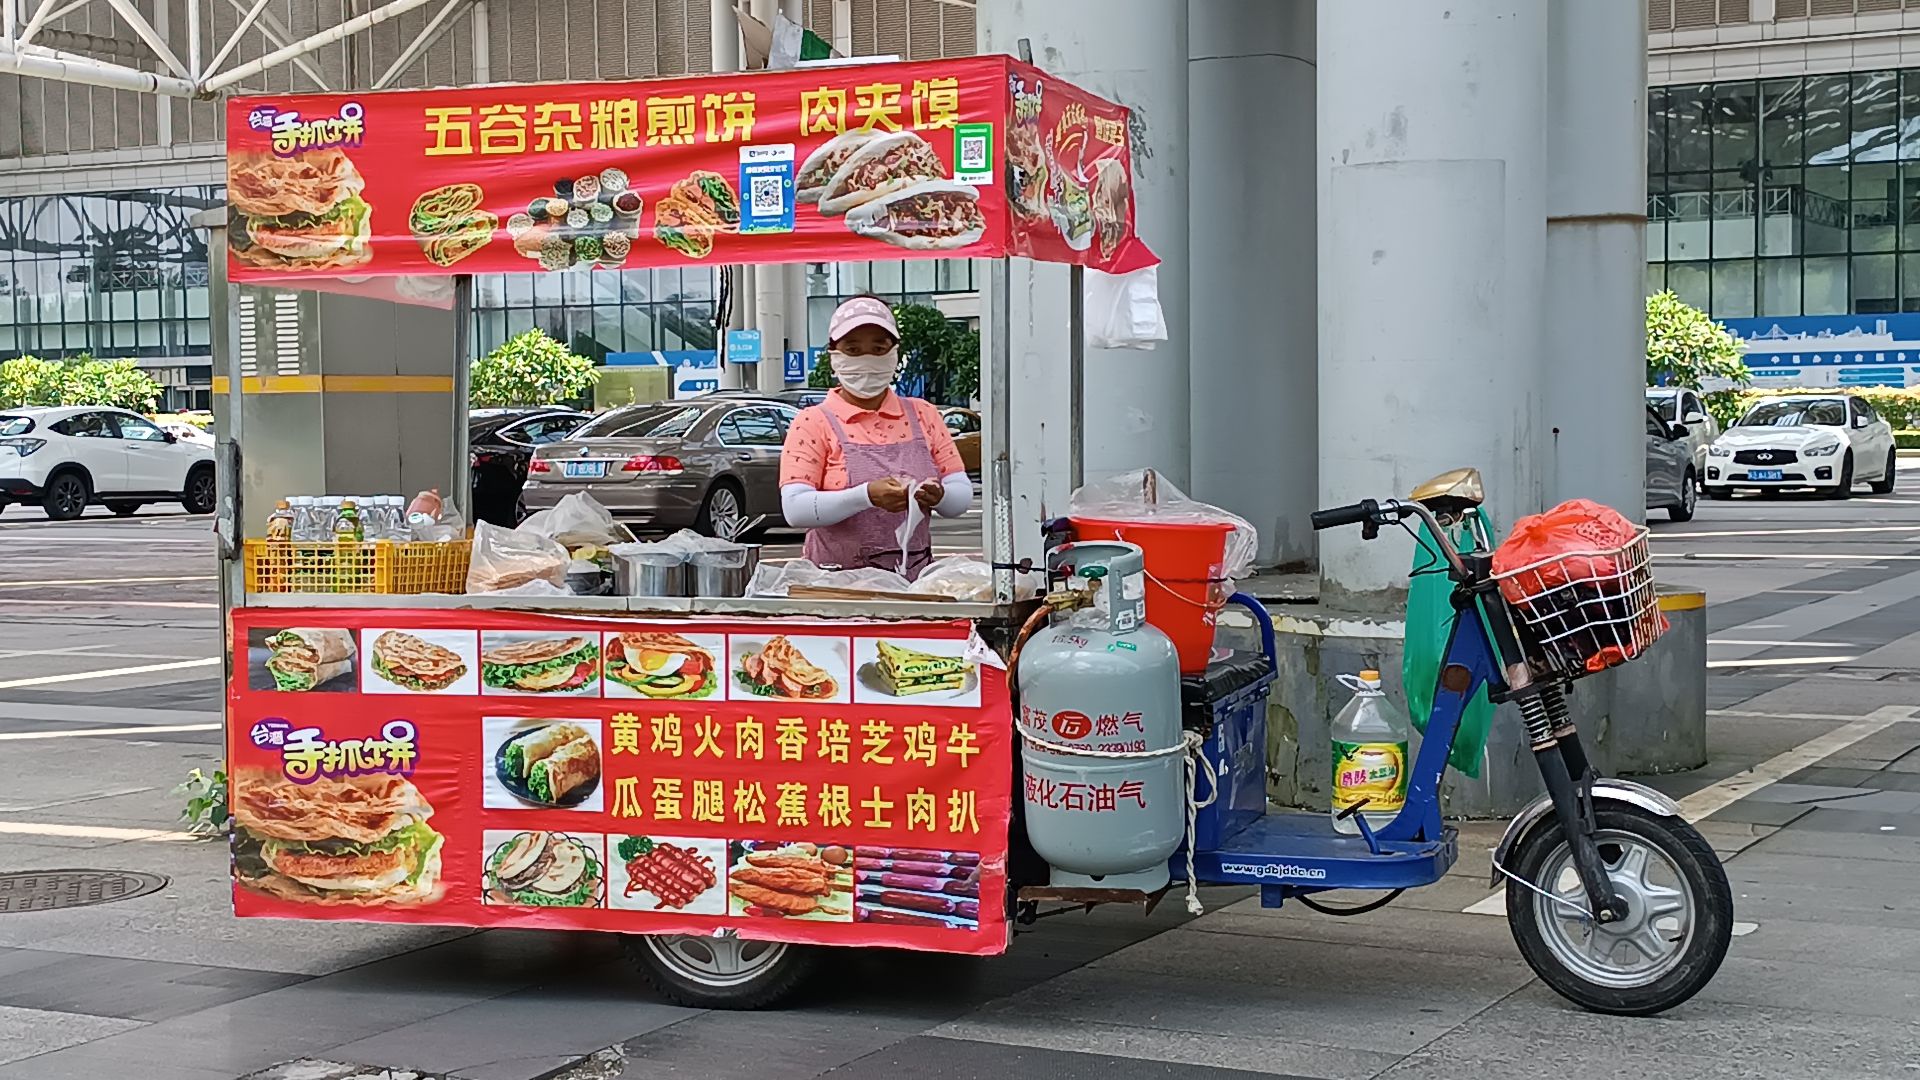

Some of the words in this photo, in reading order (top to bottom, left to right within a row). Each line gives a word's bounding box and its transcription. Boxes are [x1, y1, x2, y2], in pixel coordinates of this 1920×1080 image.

[271, 102, 364, 154] 手抓饼
[425, 91, 757, 156] 五谷杂粮煎饼
[800, 77, 959, 137] 肉夹馍
[1095, 710, 1144, 737] 燃气
[283, 720, 417, 780] 手抓饼
[1024, 772, 1147, 812] 液化石油气
